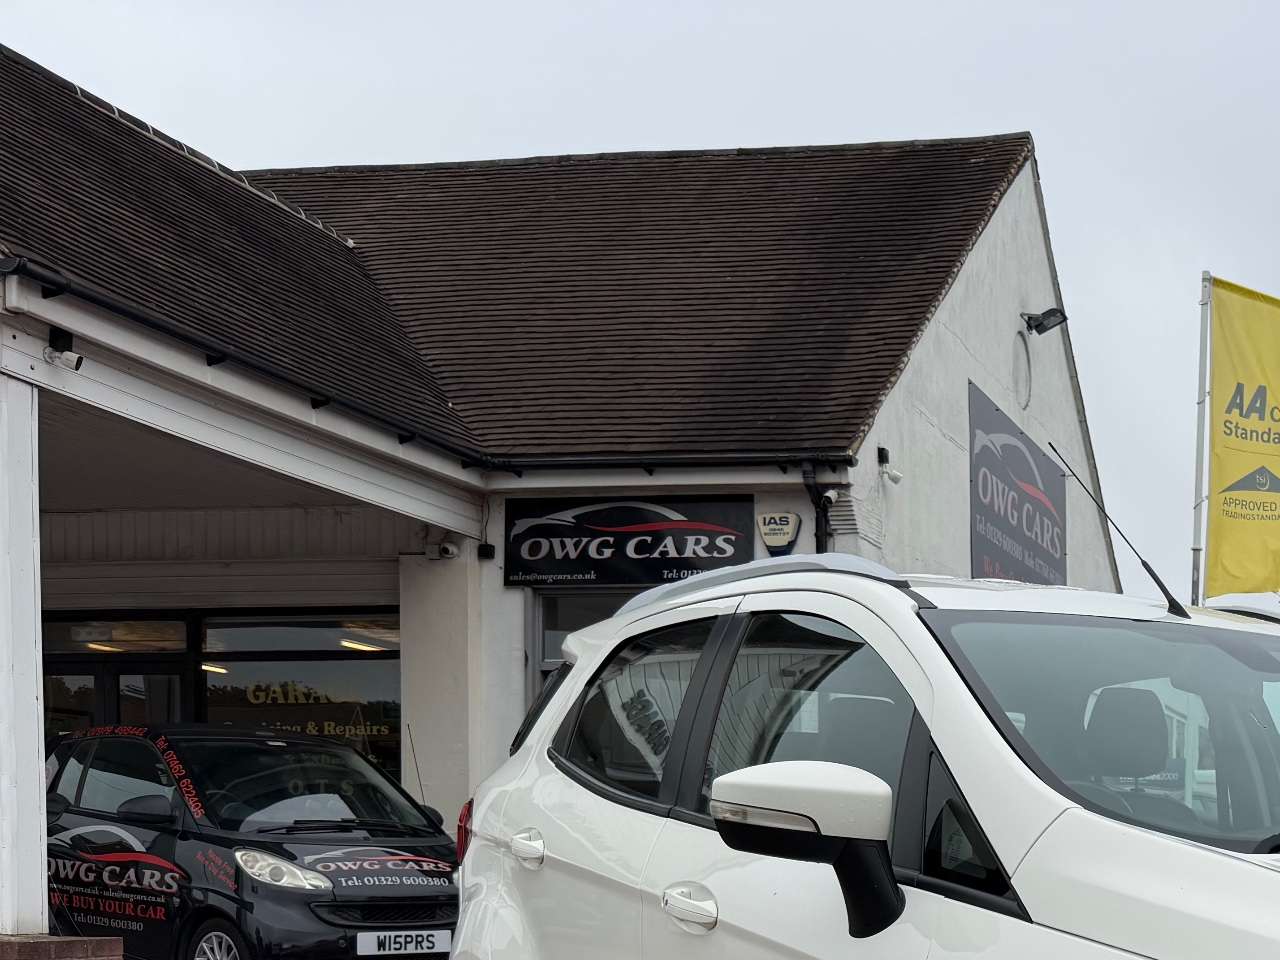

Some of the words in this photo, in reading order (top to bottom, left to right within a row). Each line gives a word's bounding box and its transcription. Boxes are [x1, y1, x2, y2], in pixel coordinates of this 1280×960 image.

[1225, 382, 1266, 421] AA
[1222, 496, 1277, 512] APPROVED
[763, 516, 789, 526] IAS
[978, 467, 1018, 527] OWG
[1022, 503, 1061, 559] CARS
[520, 536, 615, 560] OWG
[626, 534, 736, 559] CARS
[662, 568, 679, 579] Tel:
[323, 720, 390, 738] Repairs
[316, 860, 381, 872] OWG
[387, 860, 451, 872] CARS
[102, 865, 180, 893] CARS
[338, 876, 362, 887] Tel:
[364, 876, 400, 886] 01329
[403, 876, 449, 887] 600380
[72, 895, 96, 910] BUY
[98, 898, 135, 917] YOUR
[137, 904, 166, 920] CAR
[110, 918, 144, 931] 600380
